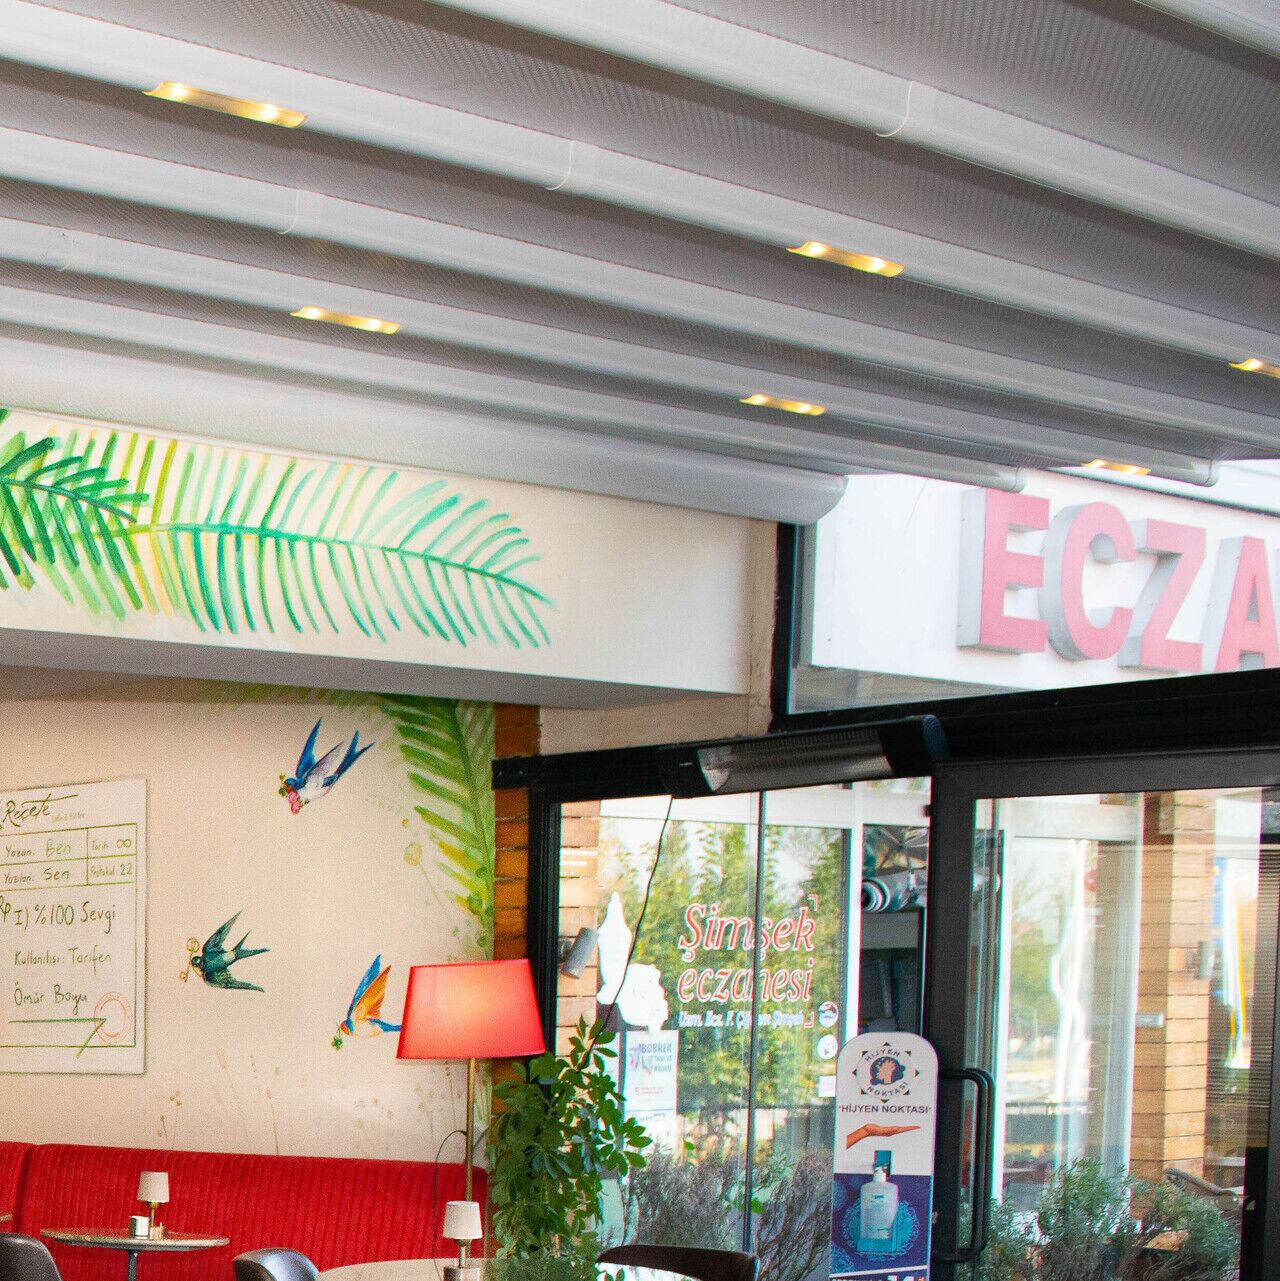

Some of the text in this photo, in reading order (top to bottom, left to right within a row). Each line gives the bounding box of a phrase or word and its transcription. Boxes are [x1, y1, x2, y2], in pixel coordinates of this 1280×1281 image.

[959, 488, 1280, 676] ECZA
[46, 839, 71, 857] Ben
[43, 867, 70, 881] Sen
[120, 863, 132, 876] 22
[35, 904, 75, 926] %100
[80, 901, 116, 934] Sevgi
[678, 903, 816, 962] Şimşek
[678, 957, 814, 1003] eczanesi
[14, 981, 87, 1015] Ömür Boyu
